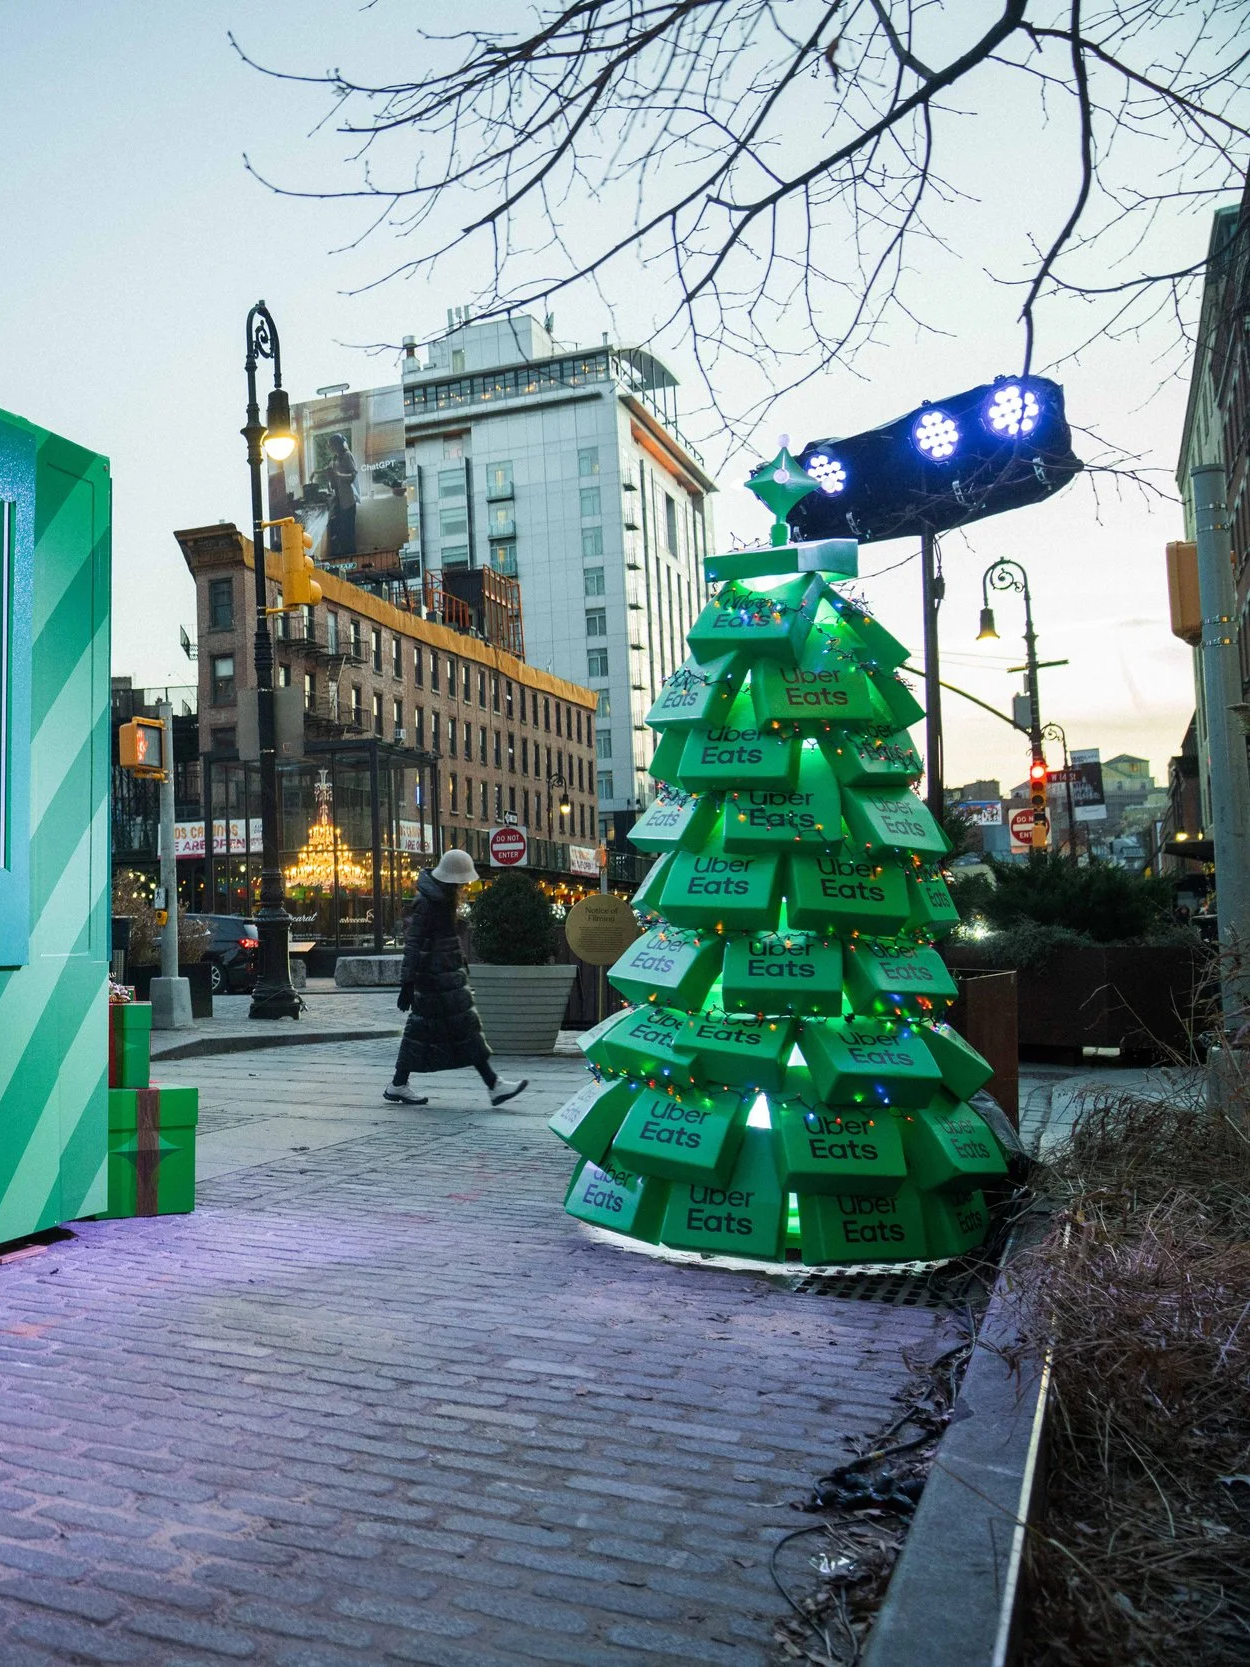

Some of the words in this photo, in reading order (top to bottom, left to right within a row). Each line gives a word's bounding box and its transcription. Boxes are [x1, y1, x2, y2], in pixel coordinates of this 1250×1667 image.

[360, 460, 396, 472] ChatGPT
[780, 667, 840, 684] Uber
[662, 691, 699, 709] Eats
[785, 687, 849, 706] Eats
[707, 725, 764, 743] Uber
[700, 746, 763, 765] Eats
[749, 792, 815, 807] Uber
[867, 794, 915, 815] Uber
[646, 811, 680, 827] Eats
[749, 810, 815, 828] Eats
[881, 815, 926, 837] Eats
[498, 851, 519, 859] ENTER
[693, 856, 755, 874] Uber
[816, 857, 879, 878] Uber
[687, 876, 749, 895] Eats
[820, 879, 886, 902] Eats
[585, 907, 608, 915] Notice
[610, 907, 618, 915] of
[588, 915, 615, 924] Filming
[646, 933, 690, 953] Uber
[749, 941, 815, 957] Uber
[864, 943, 918, 959] Uber
[630, 952, 675, 973] Eats
[748, 960, 816, 978] Eats
[878, 961, 934, 981] Eats
[646, 1011, 684, 1031] Ube
[696, 1025, 762, 1046] Eats
[837, 1031, 900, 1046] Uber
[848, 1048, 915, 1066] Eats
[651, 1100, 712, 1125] Uber
[639, 1121, 702, 1149] Eats
[804, 1116, 870, 1135] Uber
[934, 1116, 976, 1135] Uber
[809, 1138, 879, 1160] Eats
[951, 1138, 992, 1159] Eats
[594, 1162, 633, 1187] Uber
[582, 1183, 624, 1213] Eats
[690, 1184, 756, 1208] Uber
[836, 1194, 899, 1215] Uber
[686, 1208, 753, 1235] Eats
[956, 1211, 984, 1235] Eats
[842, 1220, 906, 1243] Eats
